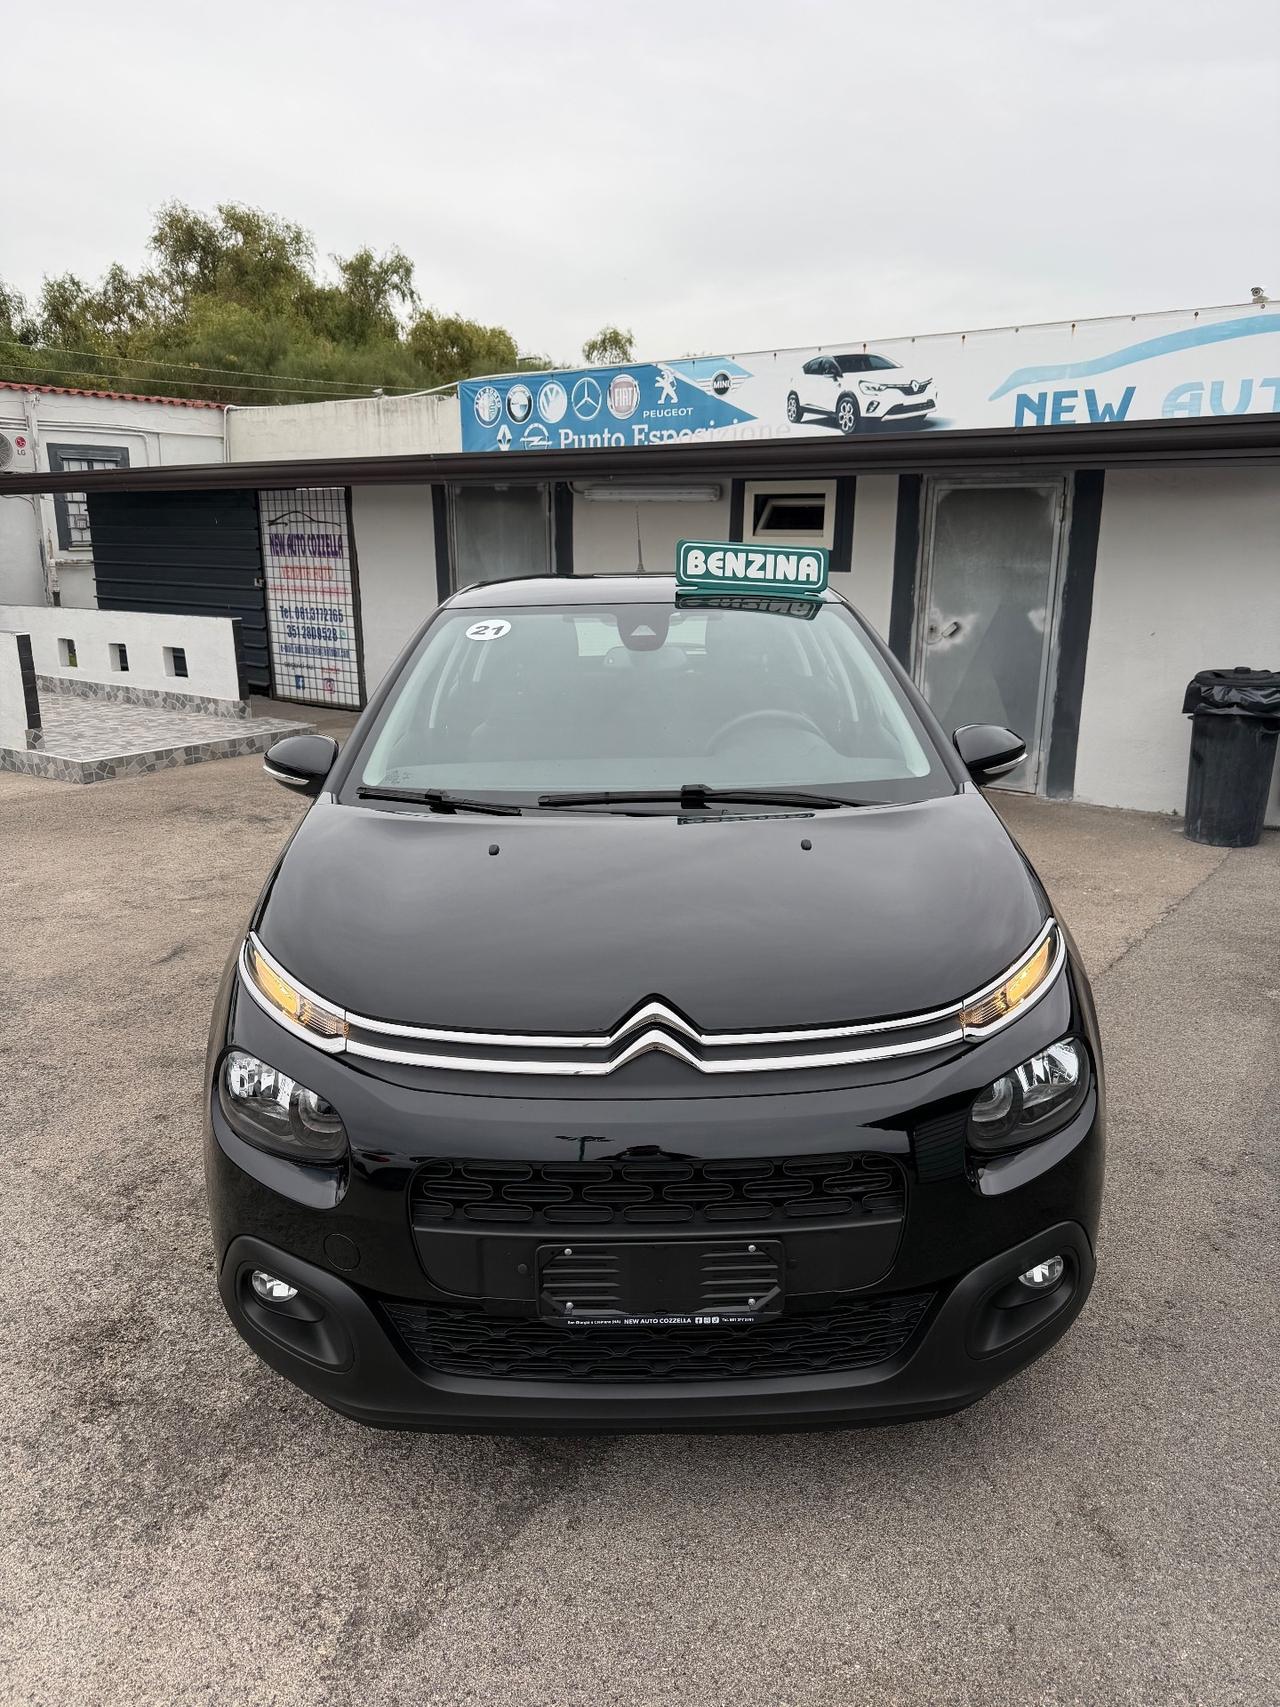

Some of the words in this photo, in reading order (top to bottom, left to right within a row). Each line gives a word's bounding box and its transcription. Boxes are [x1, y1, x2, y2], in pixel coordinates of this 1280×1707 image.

[642, 407, 694, 419] PEUGEOT
[1015, 386, 1137, 429] NEW
[558, 427, 626, 449] Punto
[269, 533, 286, 556] NEW
[286, 533, 306, 557] AUTO
[307, 534, 344, 559] COZZELLA
[686, 549, 818, 583] BENZINA
[470, 625, 505, 636] 21
